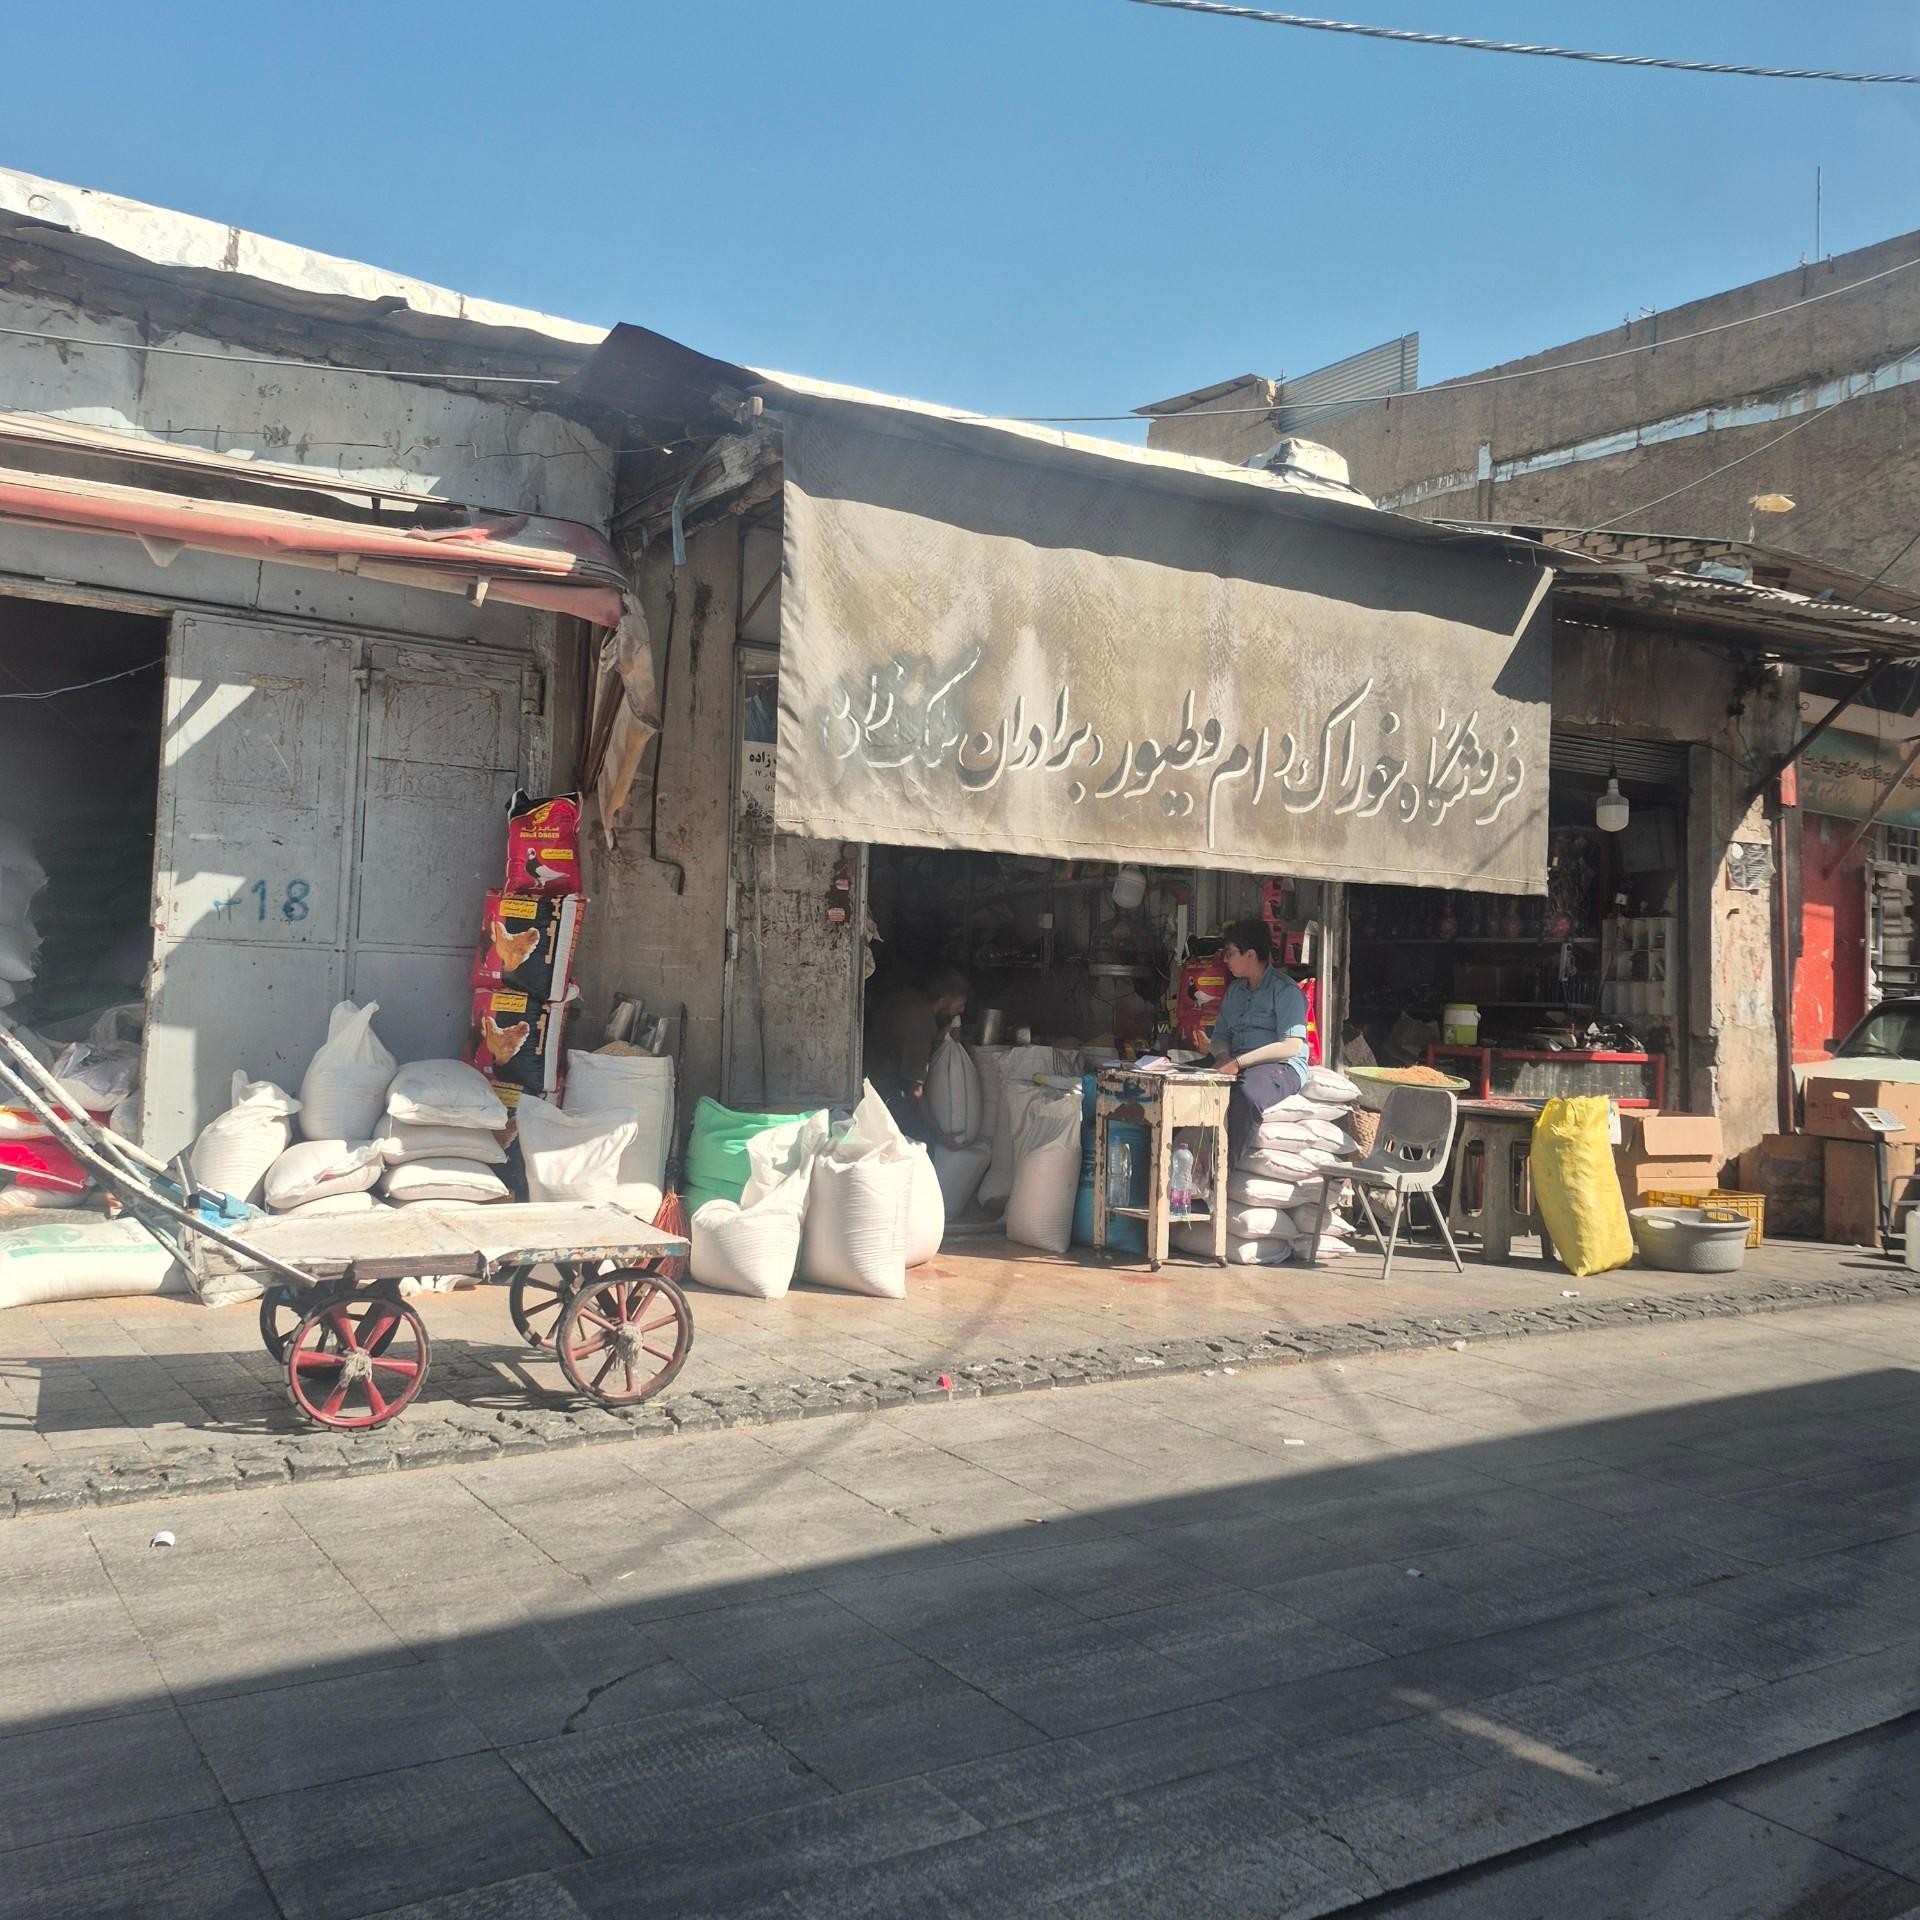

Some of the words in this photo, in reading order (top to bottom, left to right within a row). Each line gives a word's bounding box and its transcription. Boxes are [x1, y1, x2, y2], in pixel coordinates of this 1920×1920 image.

[953, 684, 1104, 805] برادران
[1095, 688, 1203, 817] طیور
[1206, 726, 1297, 849] دام
[1281, 677, 1408, 818] خوراک
[1400, 706, 1525, 826] فروشگاه
